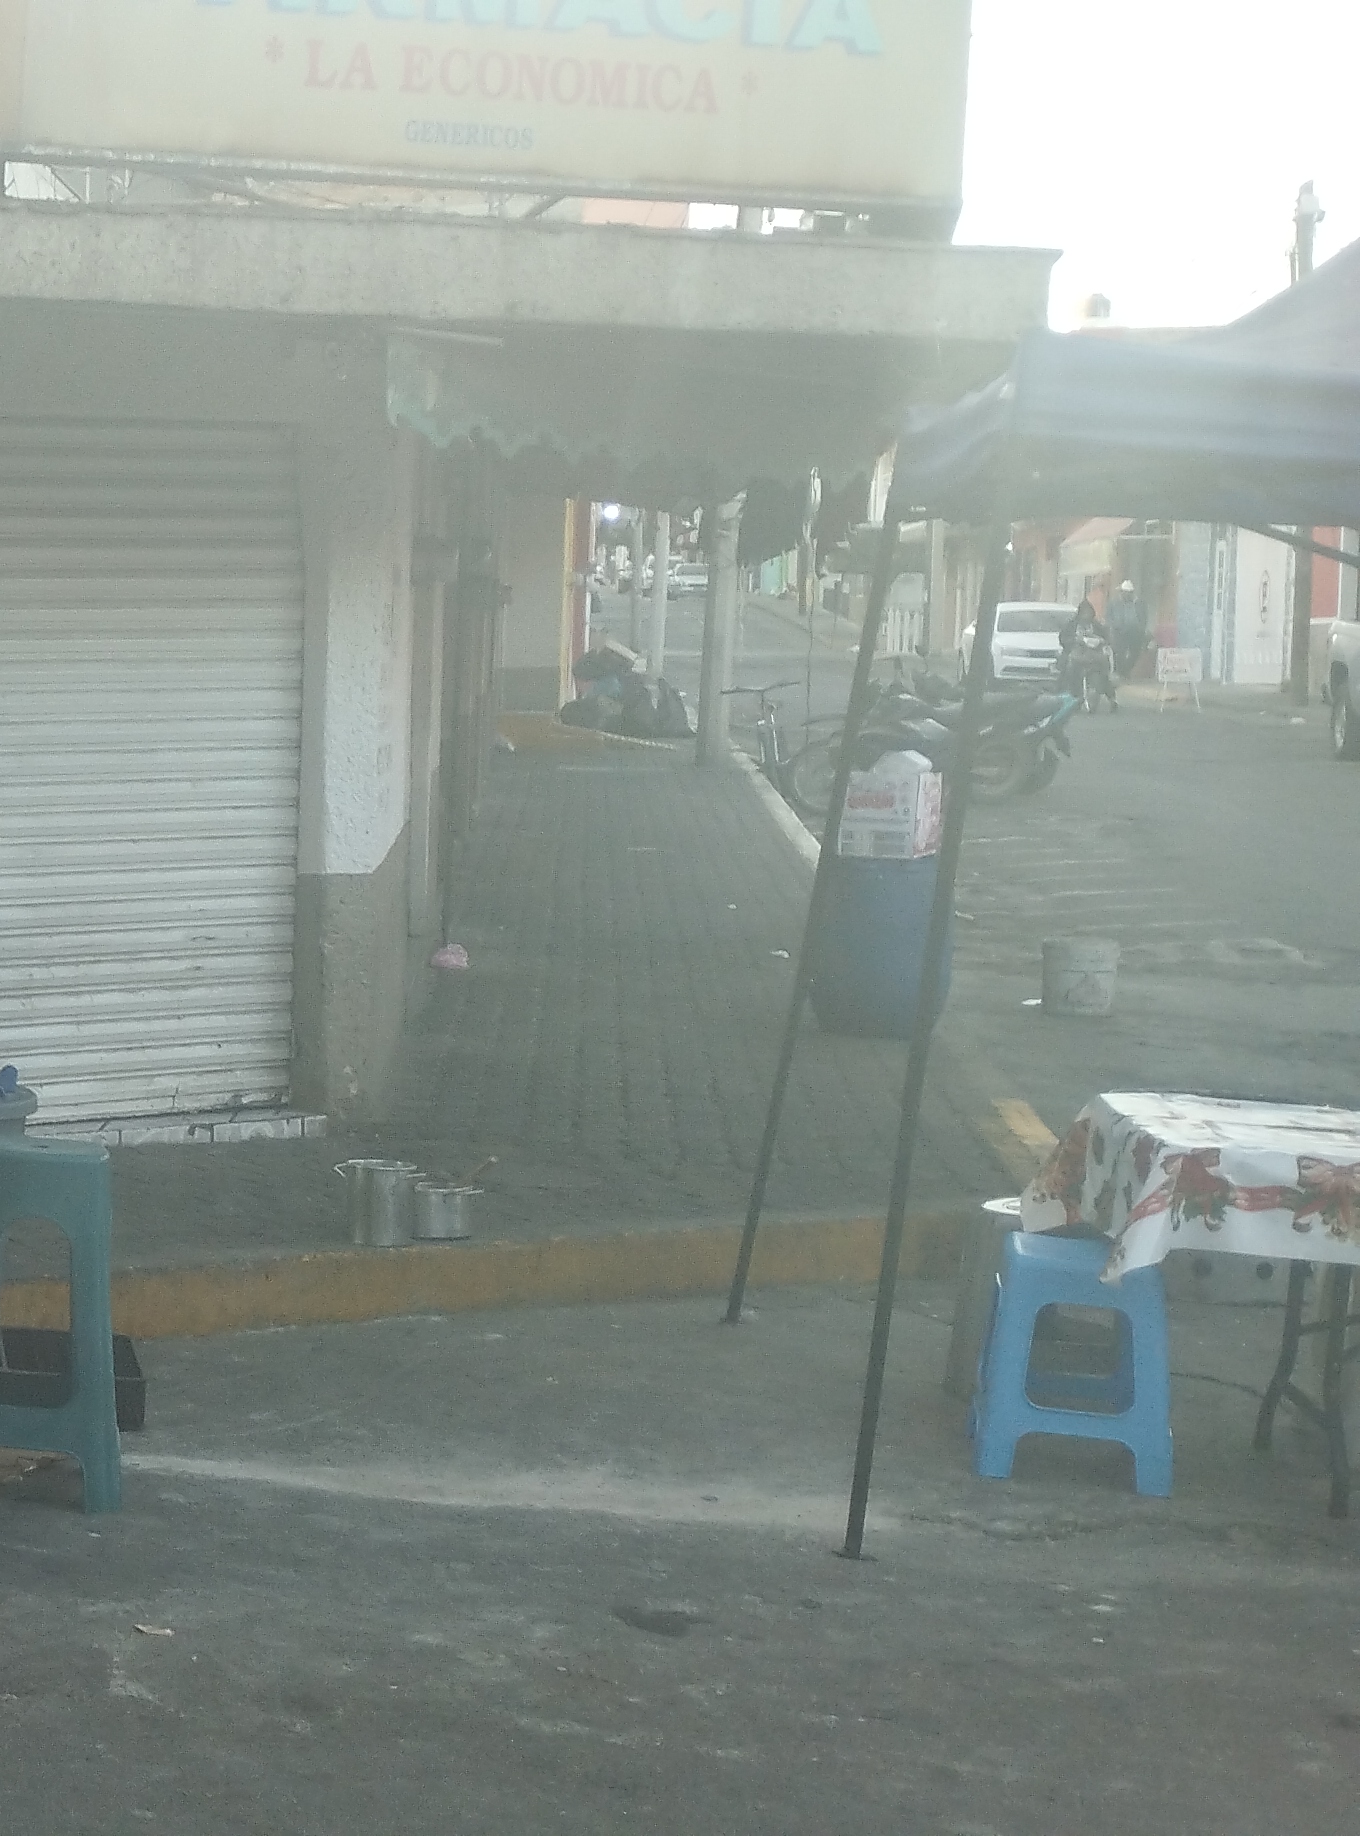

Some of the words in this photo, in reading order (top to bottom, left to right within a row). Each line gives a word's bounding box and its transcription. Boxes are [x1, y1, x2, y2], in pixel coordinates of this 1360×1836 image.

[302, 39, 379, 92] LA
[398, 46, 720, 115] ECONOMICA
[403, 118, 536, 151] GENERICOS
